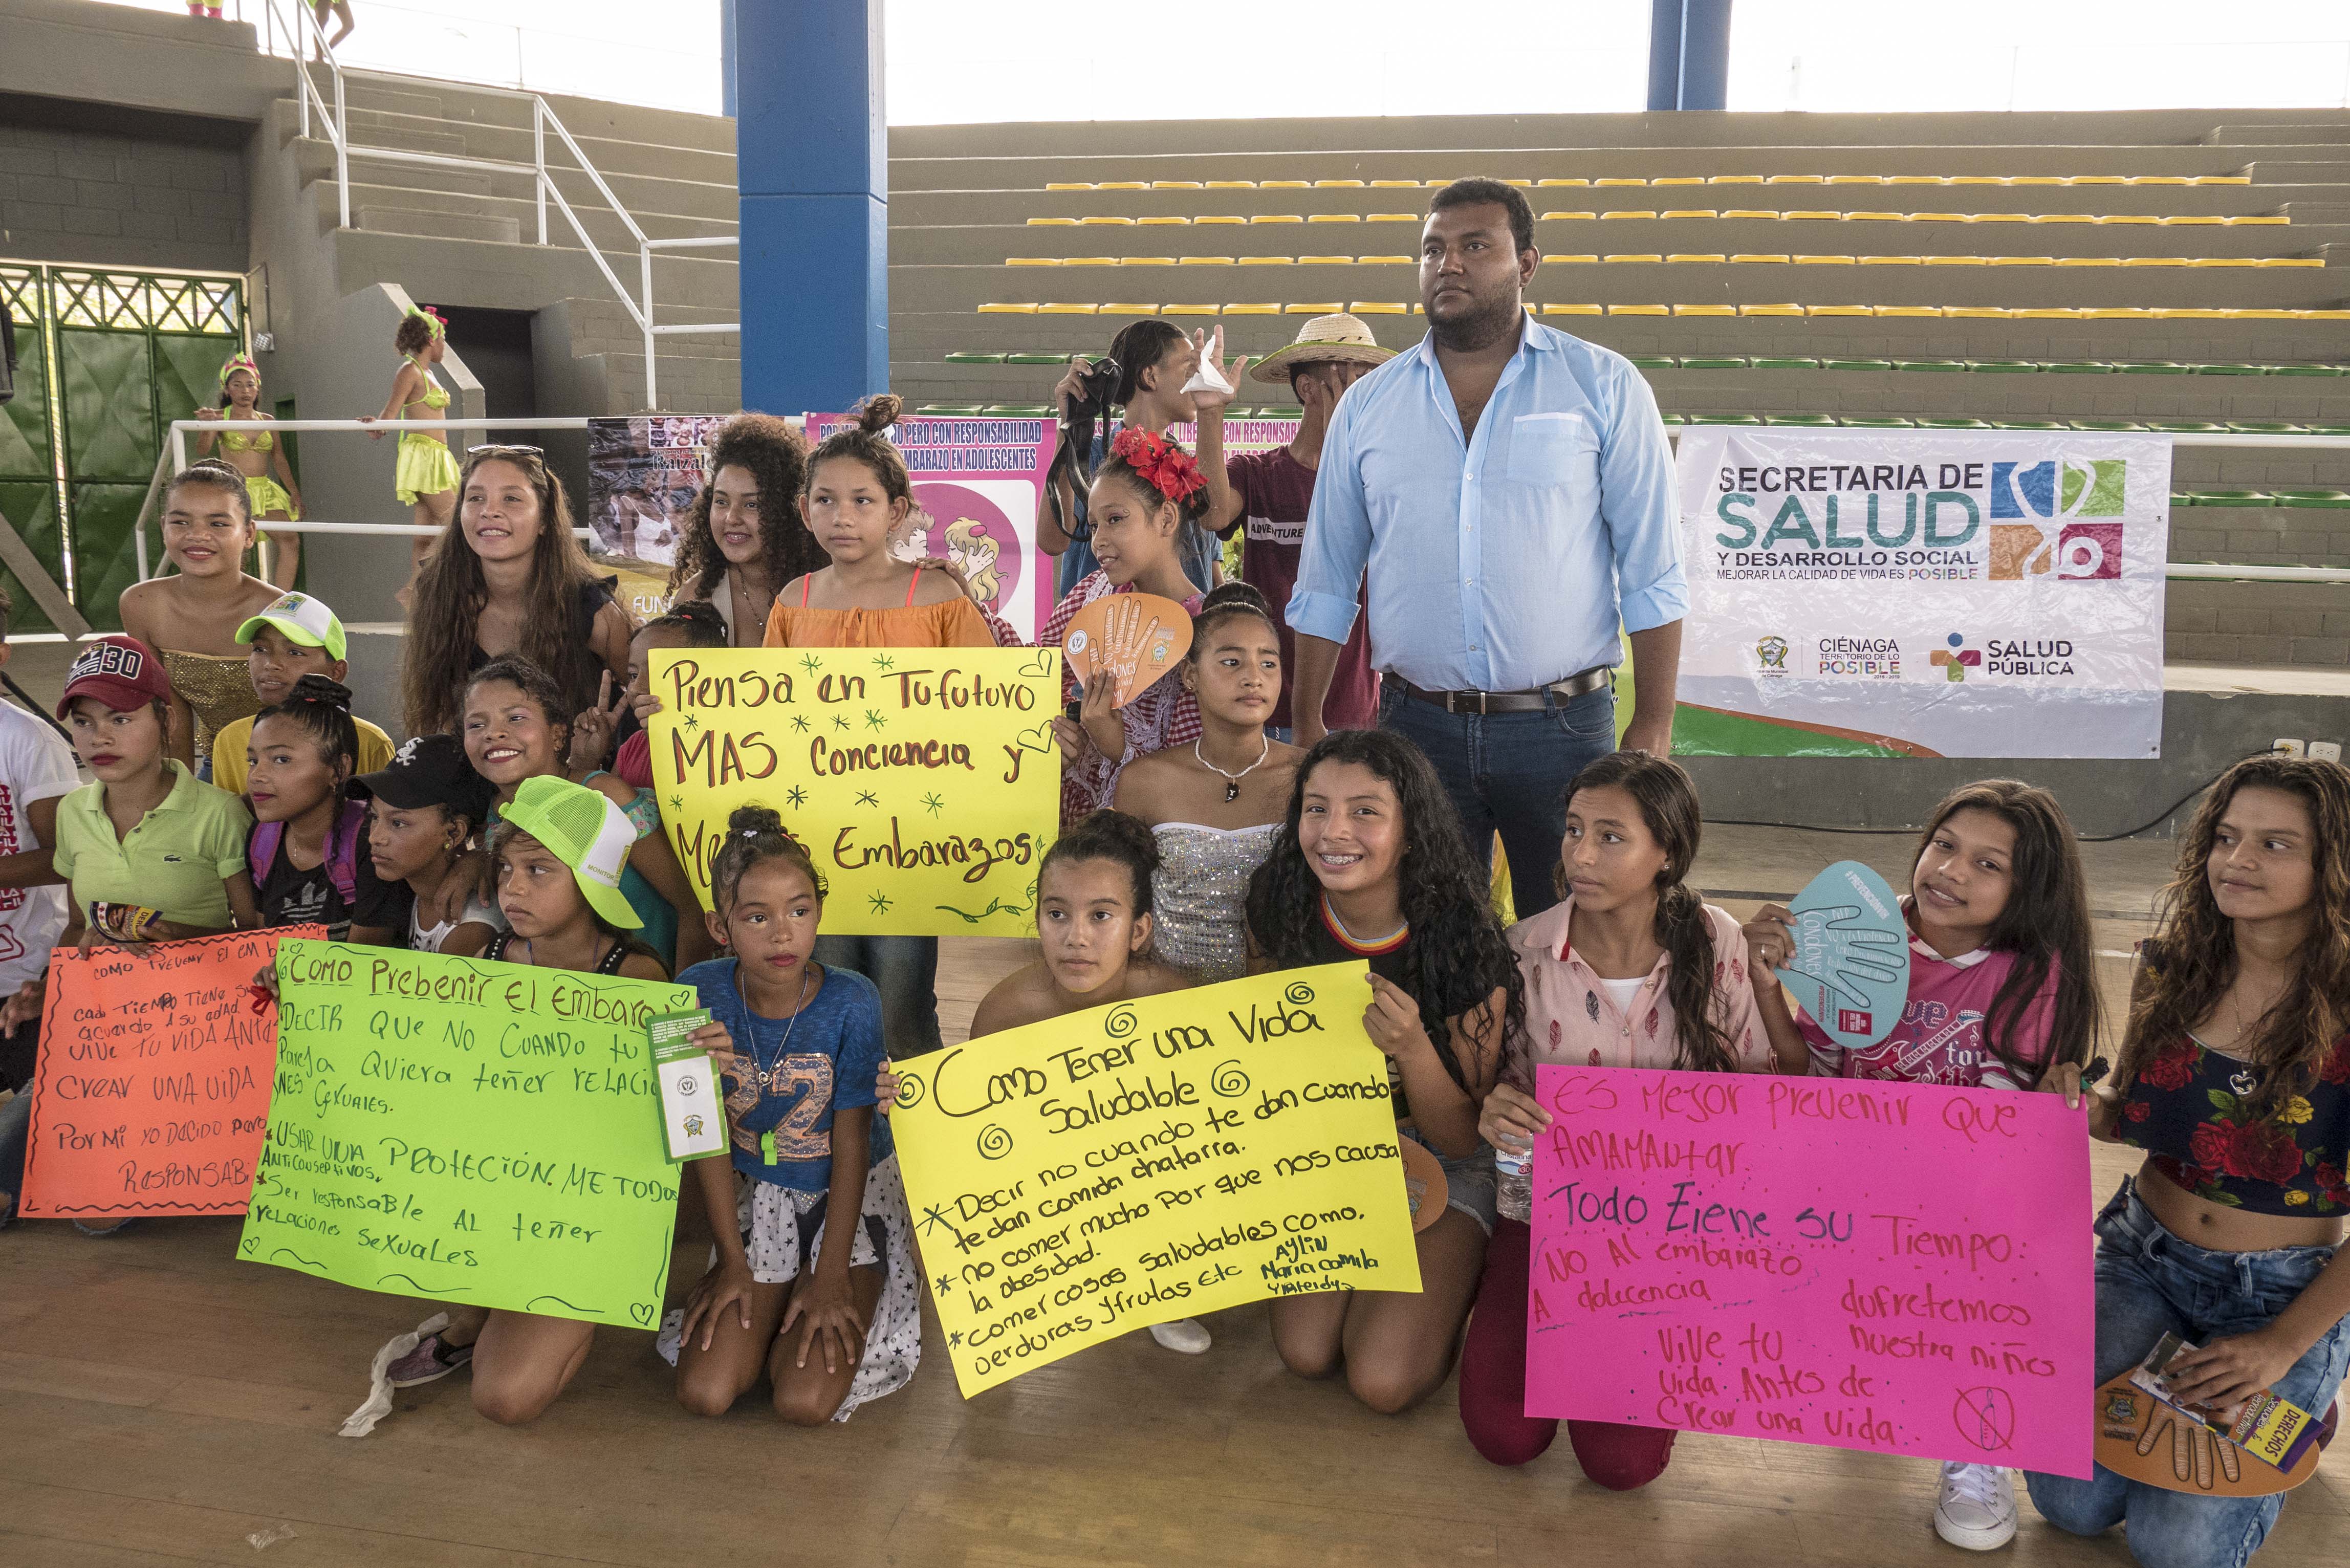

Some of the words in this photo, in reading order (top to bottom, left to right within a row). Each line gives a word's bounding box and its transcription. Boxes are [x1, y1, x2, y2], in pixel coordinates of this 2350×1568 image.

[906, 424, 929, 445] PERO
[932, 423, 952, 445] CON
[954, 421, 1042, 444] RESPONSABILIDAD
[653, 453, 705, 470] Raizal
[901, 448, 950, 471] MBARAZO
[952, 448, 963, 470] EN
[965, 447, 1036, 471] ADOLESCENTES
[1719, 464, 1928, 492] SECRETARIA
[1940, 464, 1984, 489] DE
[1251, 524, 1303, 538] ADVENTURE
[1715, 491, 1979, 550] SALUD
[1717, 553, 1729, 567] Y
[1735, 551, 1889, 567] DESARROLLO
[1895, 550, 1978, 565] SOCIAL
[1717, 569, 1770, 580] MEJORAR
[1773, 569, 1787, 580] LA
[1789, 569, 1839, 580] CALIDAD
[1842, 569, 1856, 579] DE
[1859, 569, 1887, 579] VIDA
[1890, 569, 1904, 579] ES
[1908, 568, 1978, 580] POSIBLE
[1819, 636, 1899, 653] CIÉNAGA
[1988, 640, 2073, 658] SALUD
[102, 645, 143, 680] 30
[1819, 661, 1900, 675] POSIBLE
[1989, 657, 2074, 676] PÚBLICA
[663, 660, 796, 712] Piensa
[672, 727, 778, 788] MAS
[811, 735, 975, 776] Conciencia
[833, 816, 1032, 884] Embarazos
[443, 1019, 475, 1052] NO
[1047, 1038, 1142, 1084] Tener
[1152, 1025, 1215, 1059] una
[1228, 1000, 1325, 1043] Vida
[1039, 1070, 1200, 1134] Saludable
[953, 1180, 1024, 1223] Decir
[1038, 1164, 1077, 1187] no
[1205, 1106, 1245, 1134] te
[1038, 1175, 1124, 1217] comida
[962, 1261, 995, 1285] no
[1001, 1224, 1071, 1267] comer
[1273, 1150, 1331, 1177] nos
[1544, 1247, 1587, 1283] NO
[968, 1293, 1047, 1347] comer
[969, 1290, 993, 1315] la
[1838, 1363, 1875, 1398] de
[2265, 1408, 2301, 1457] DERECHOS
